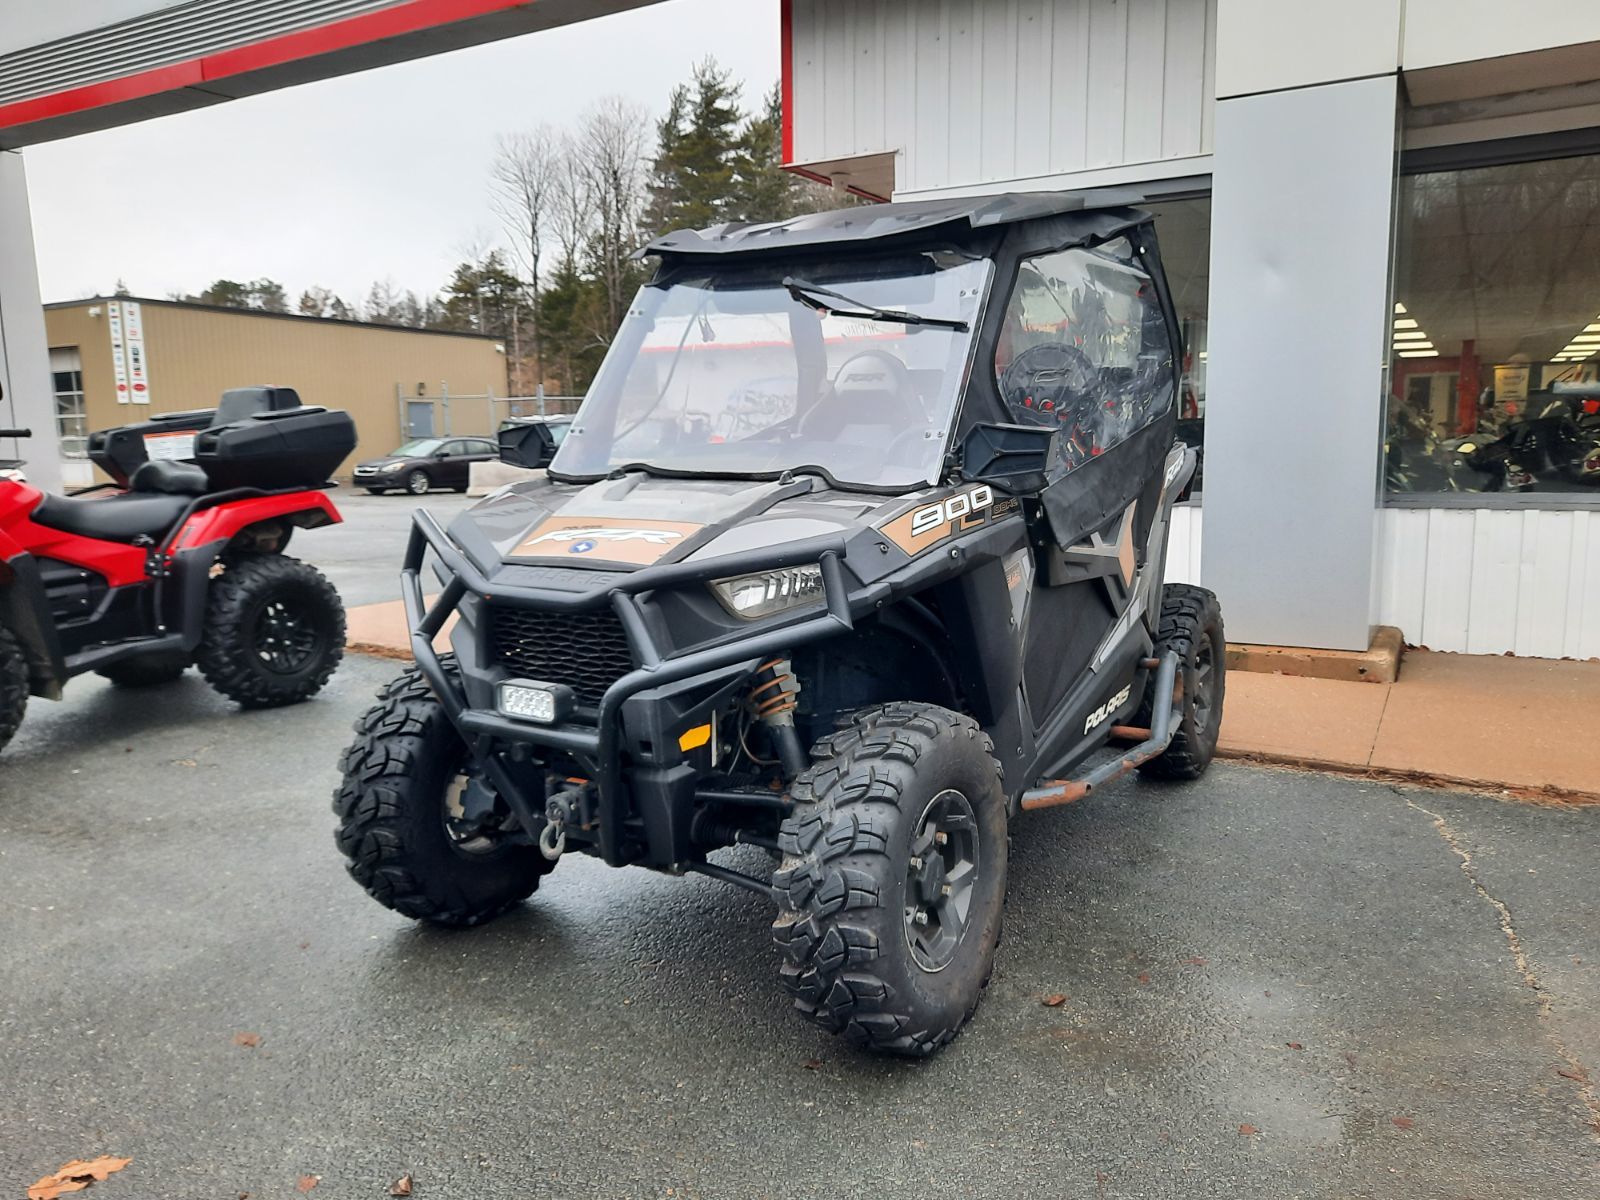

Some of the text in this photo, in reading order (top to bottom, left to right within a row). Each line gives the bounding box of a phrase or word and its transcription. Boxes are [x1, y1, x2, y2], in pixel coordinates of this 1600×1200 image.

[911, 484, 993, 537] 900
[523, 528, 683, 546] RZR
[1083, 683, 1132, 735] POLARIS
